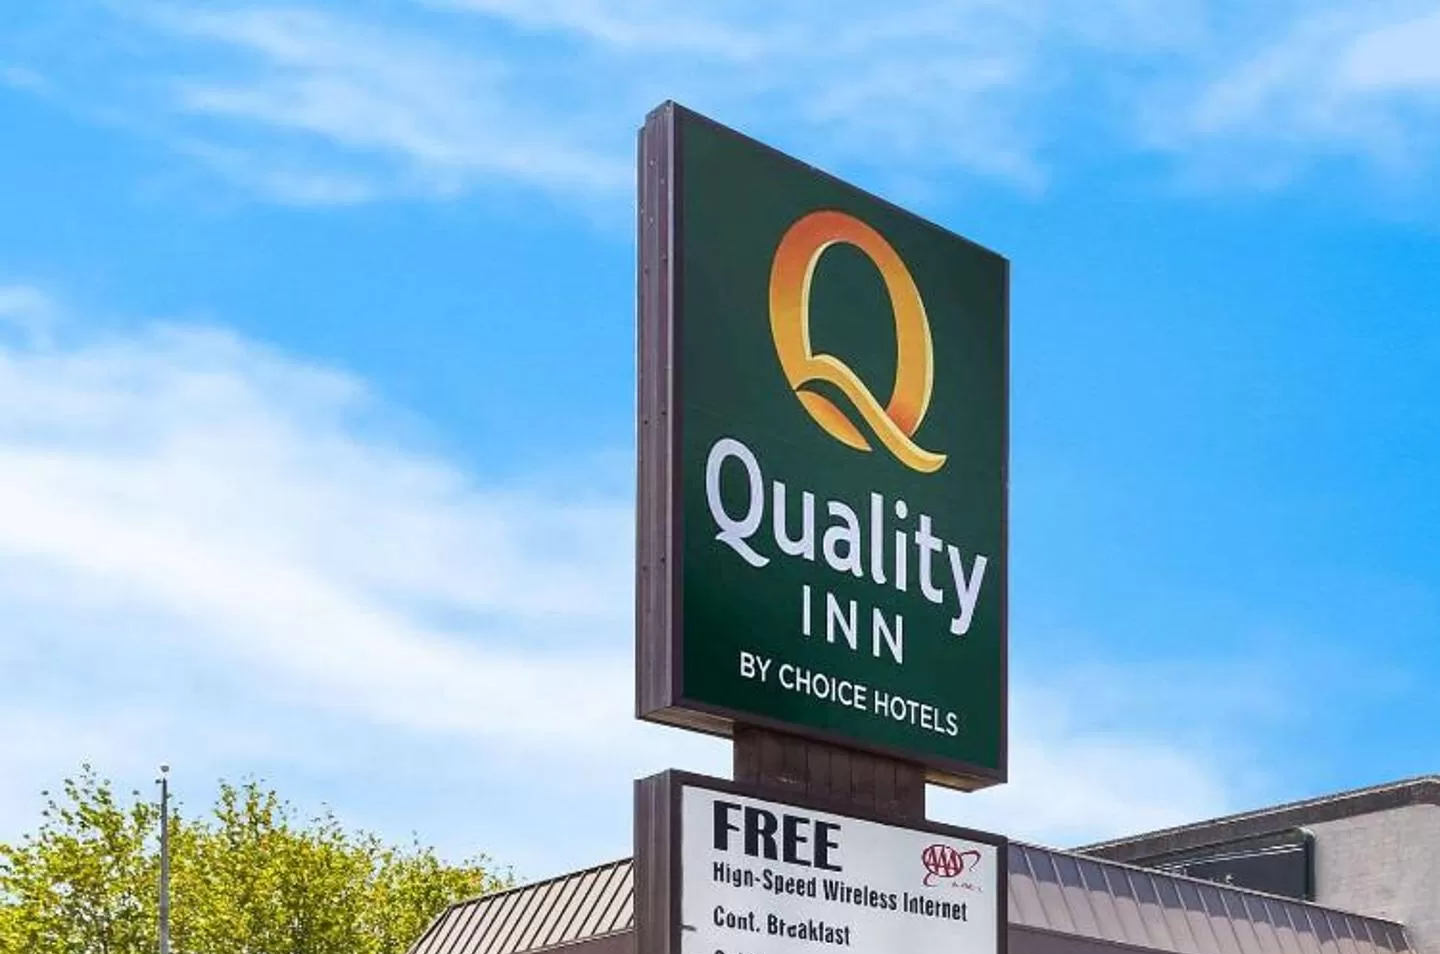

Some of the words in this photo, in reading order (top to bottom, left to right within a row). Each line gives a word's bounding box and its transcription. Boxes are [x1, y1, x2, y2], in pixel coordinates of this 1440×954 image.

[705, 438, 988, 637] Quality
[802, 584, 904, 664] INN
[740, 651, 772, 682] BY
[778, 663, 867, 711] CHOICE
[874, 690, 959, 737] HOTELS
[713, 799, 844, 873] FREE
[926, 849, 960, 878] AAA
[713, 905, 761, 933] Cont.
[822, 878, 898, 911] Wireless
[903, 891, 968, 922] Internet
